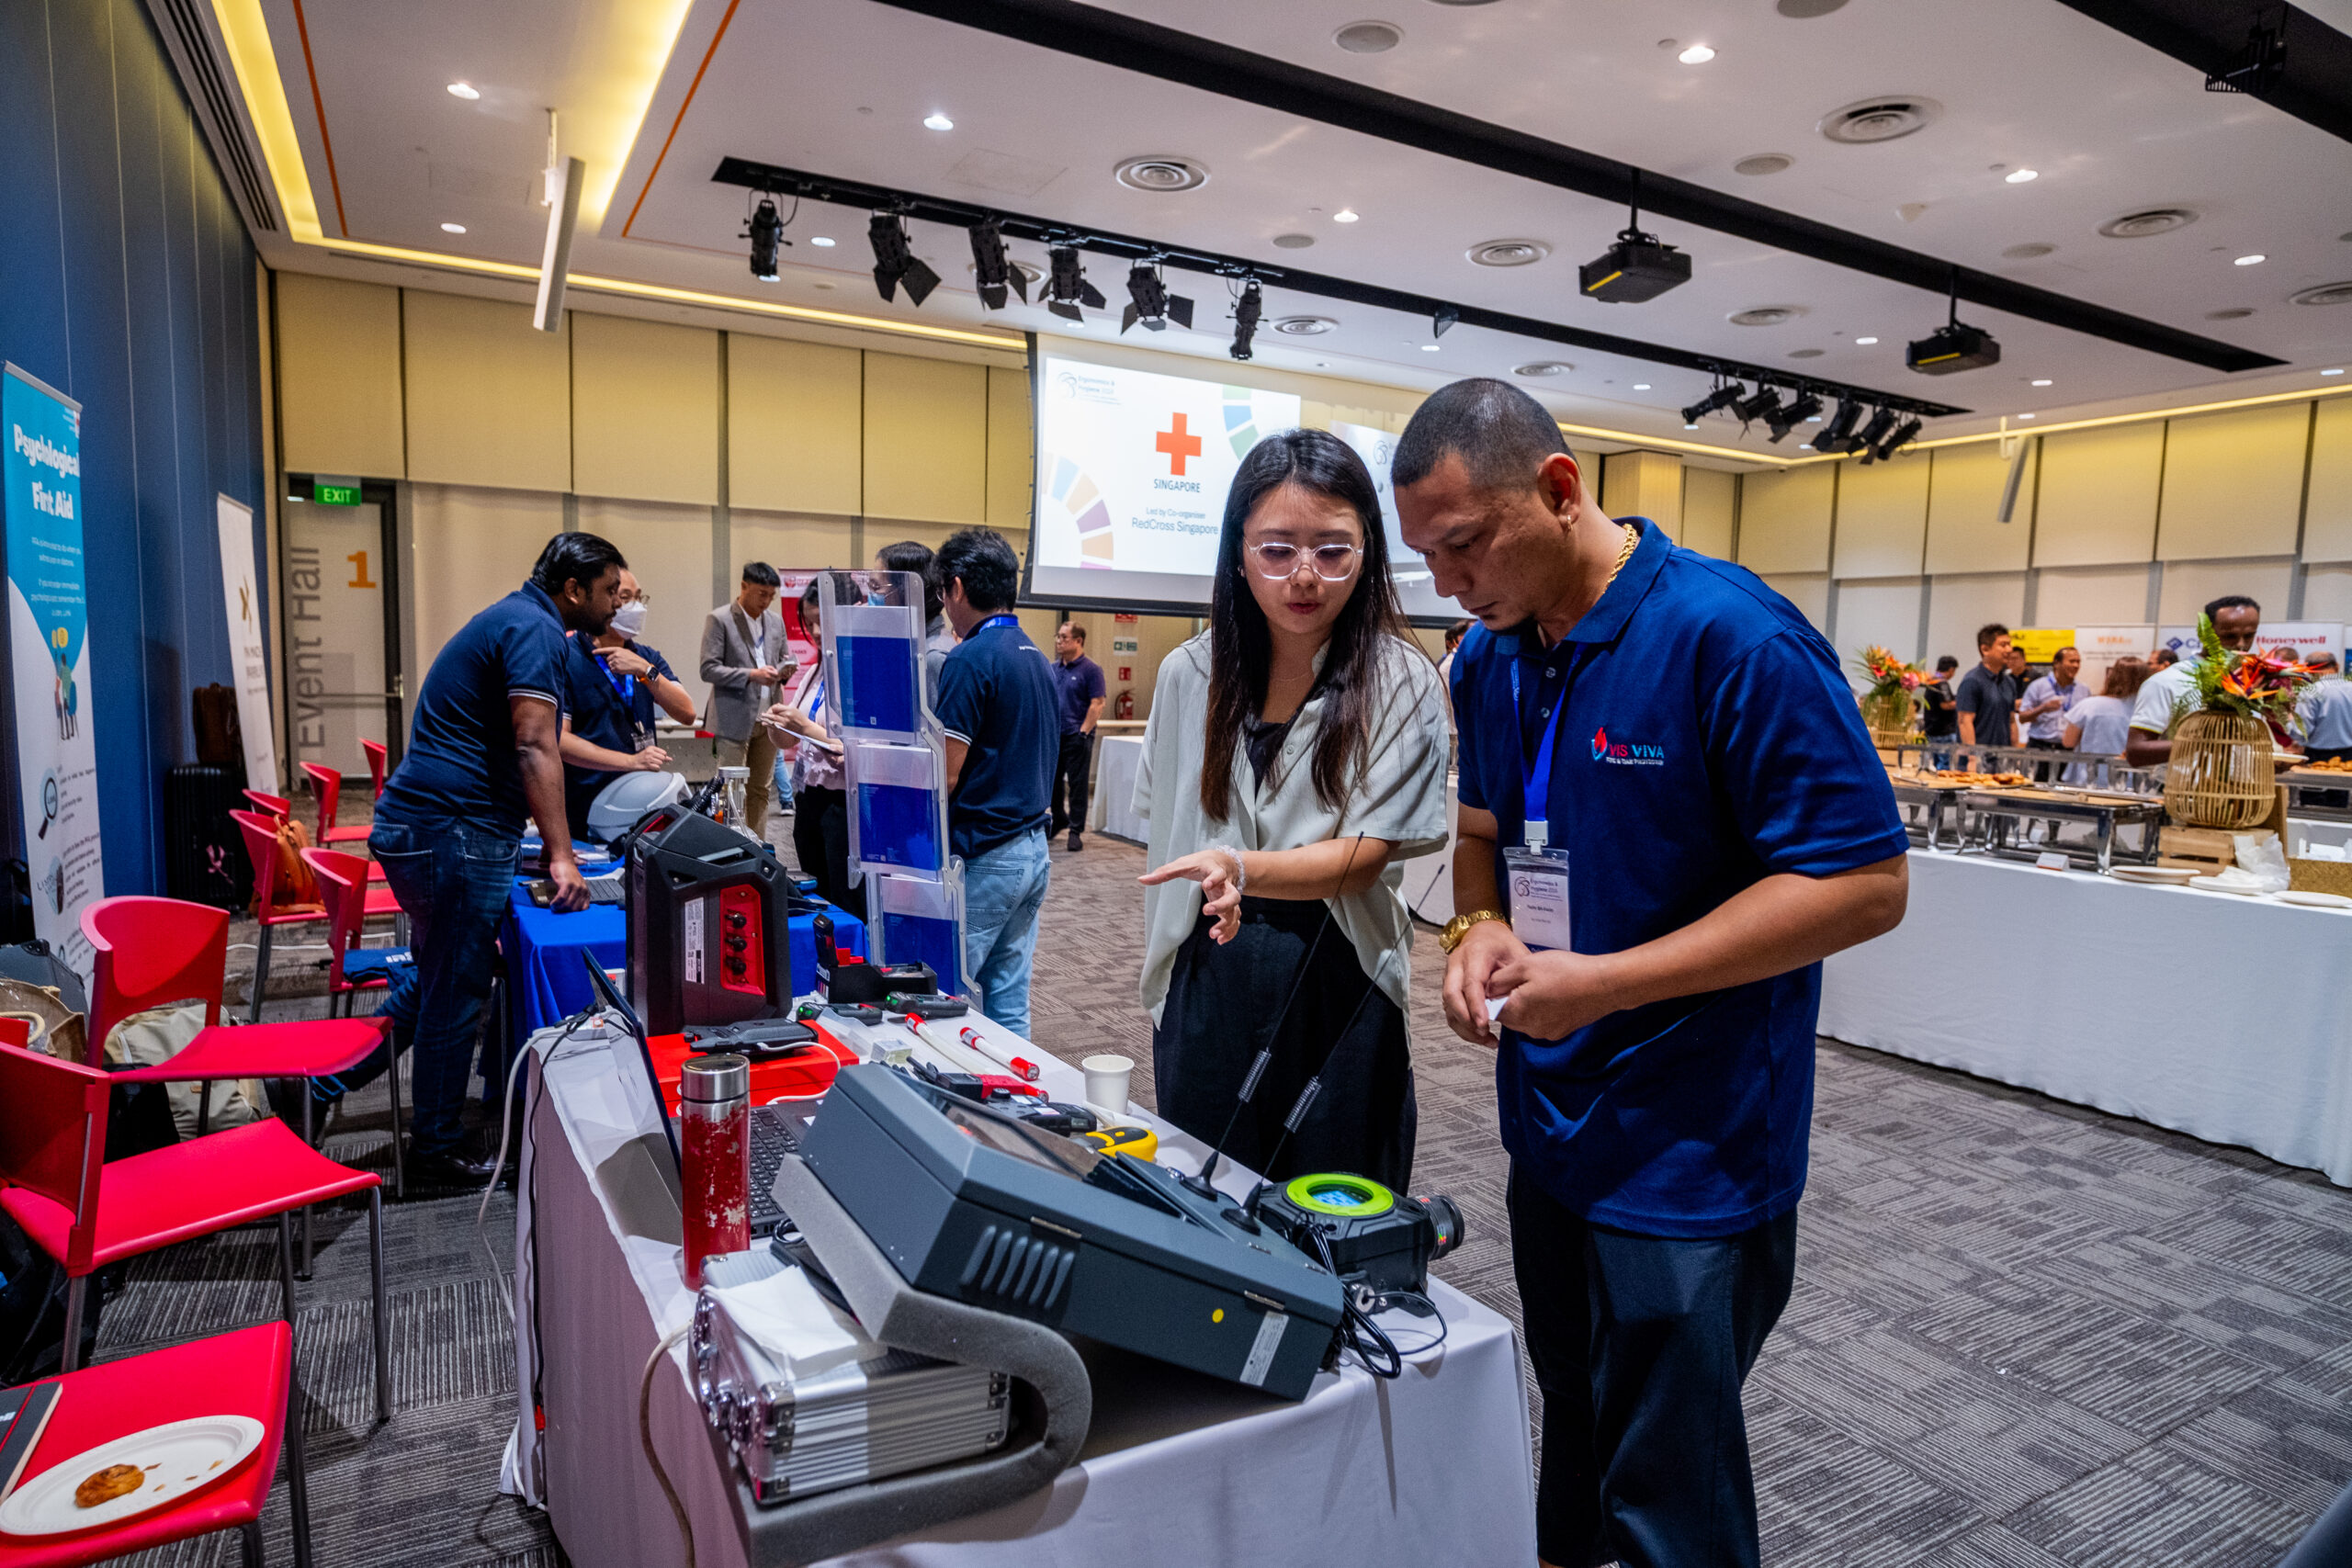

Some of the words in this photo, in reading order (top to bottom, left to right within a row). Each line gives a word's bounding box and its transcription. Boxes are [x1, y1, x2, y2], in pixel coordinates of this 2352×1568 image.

[14, 423, 80, 479] Psychological
[31, 480, 54, 515] First
[55, 491, 74, 520] Aid
[323, 488, 351, 502] EXIT
[1154, 479, 1201, 493] SINGAPORE
[1132, 517, 1175, 531] RedCross
[1177, 521, 1219, 536] Singapore
[347, 550, 377, 588] 1
[291, 547, 321, 622] Hall
[2256, 636, 2326, 646] Honeywell
[295, 637, 325, 749] Event
[1610, 744, 1628, 757] VIS
[1632, 744, 1664, 759] VIVA
